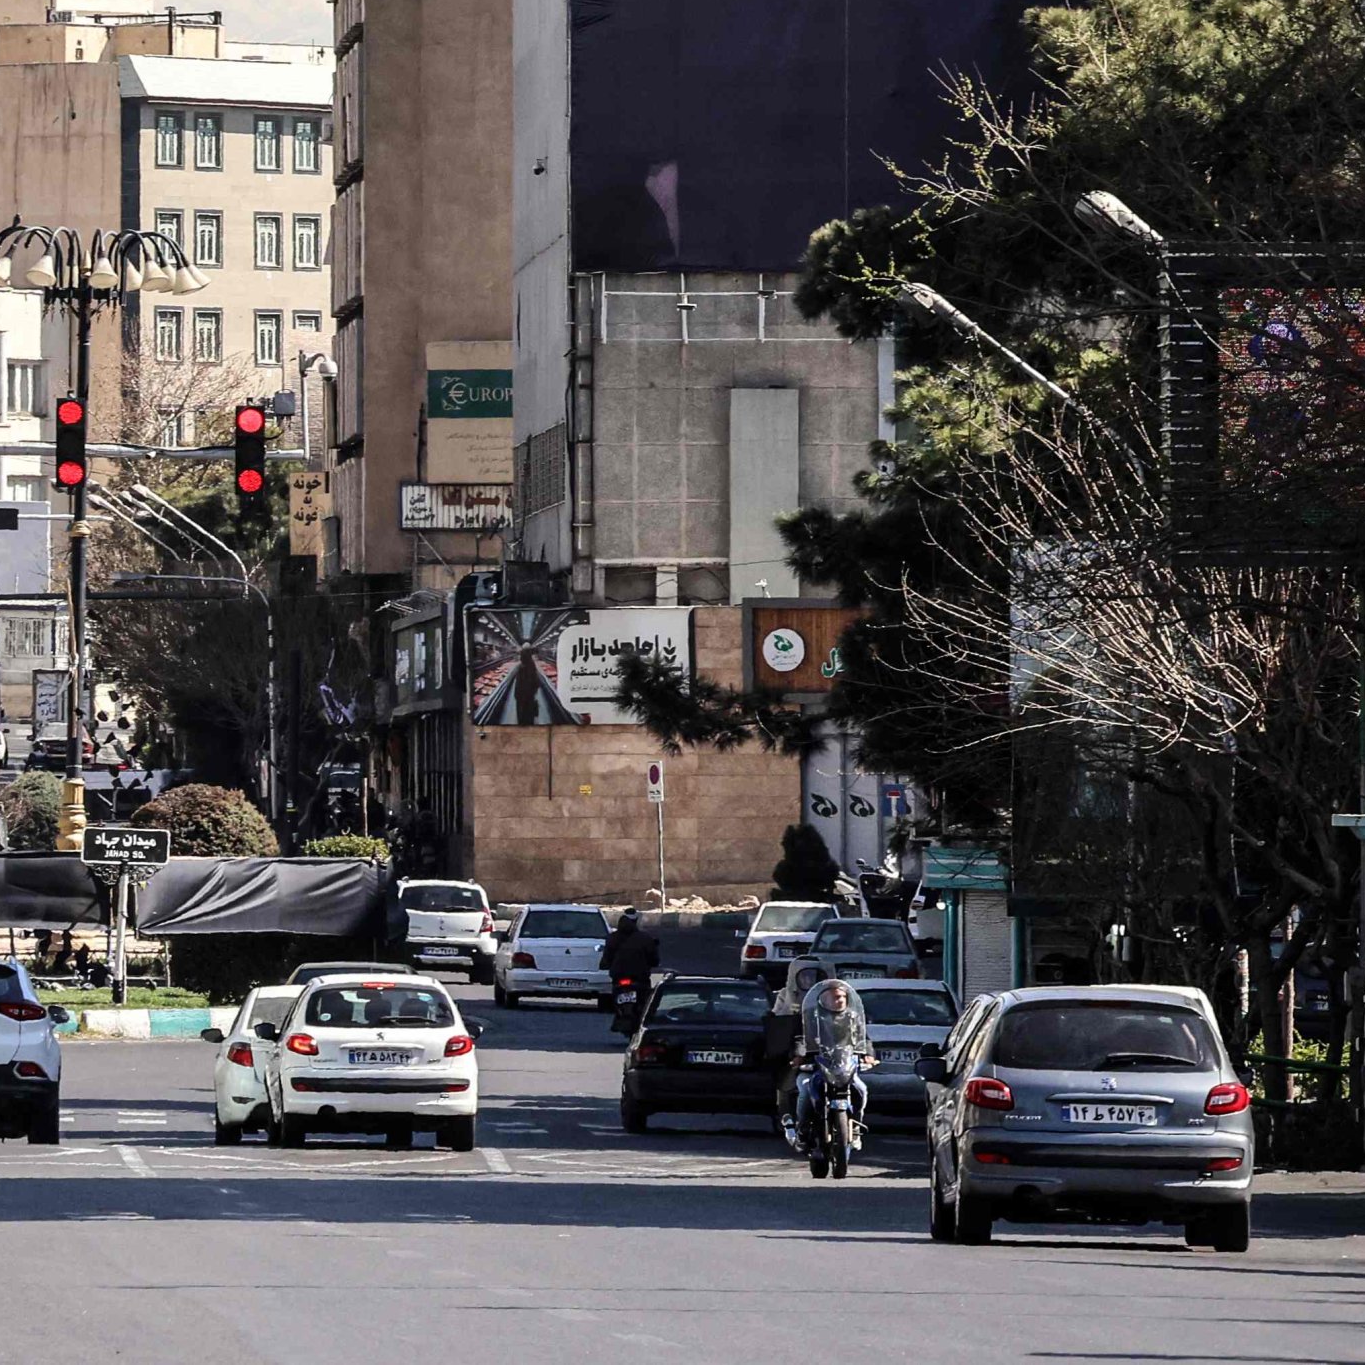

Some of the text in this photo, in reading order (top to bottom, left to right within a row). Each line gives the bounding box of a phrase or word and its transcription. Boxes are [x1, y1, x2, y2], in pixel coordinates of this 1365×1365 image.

[95, 832, 156, 847] میدان جهاد
[104, 850, 129, 858] JAHAD
